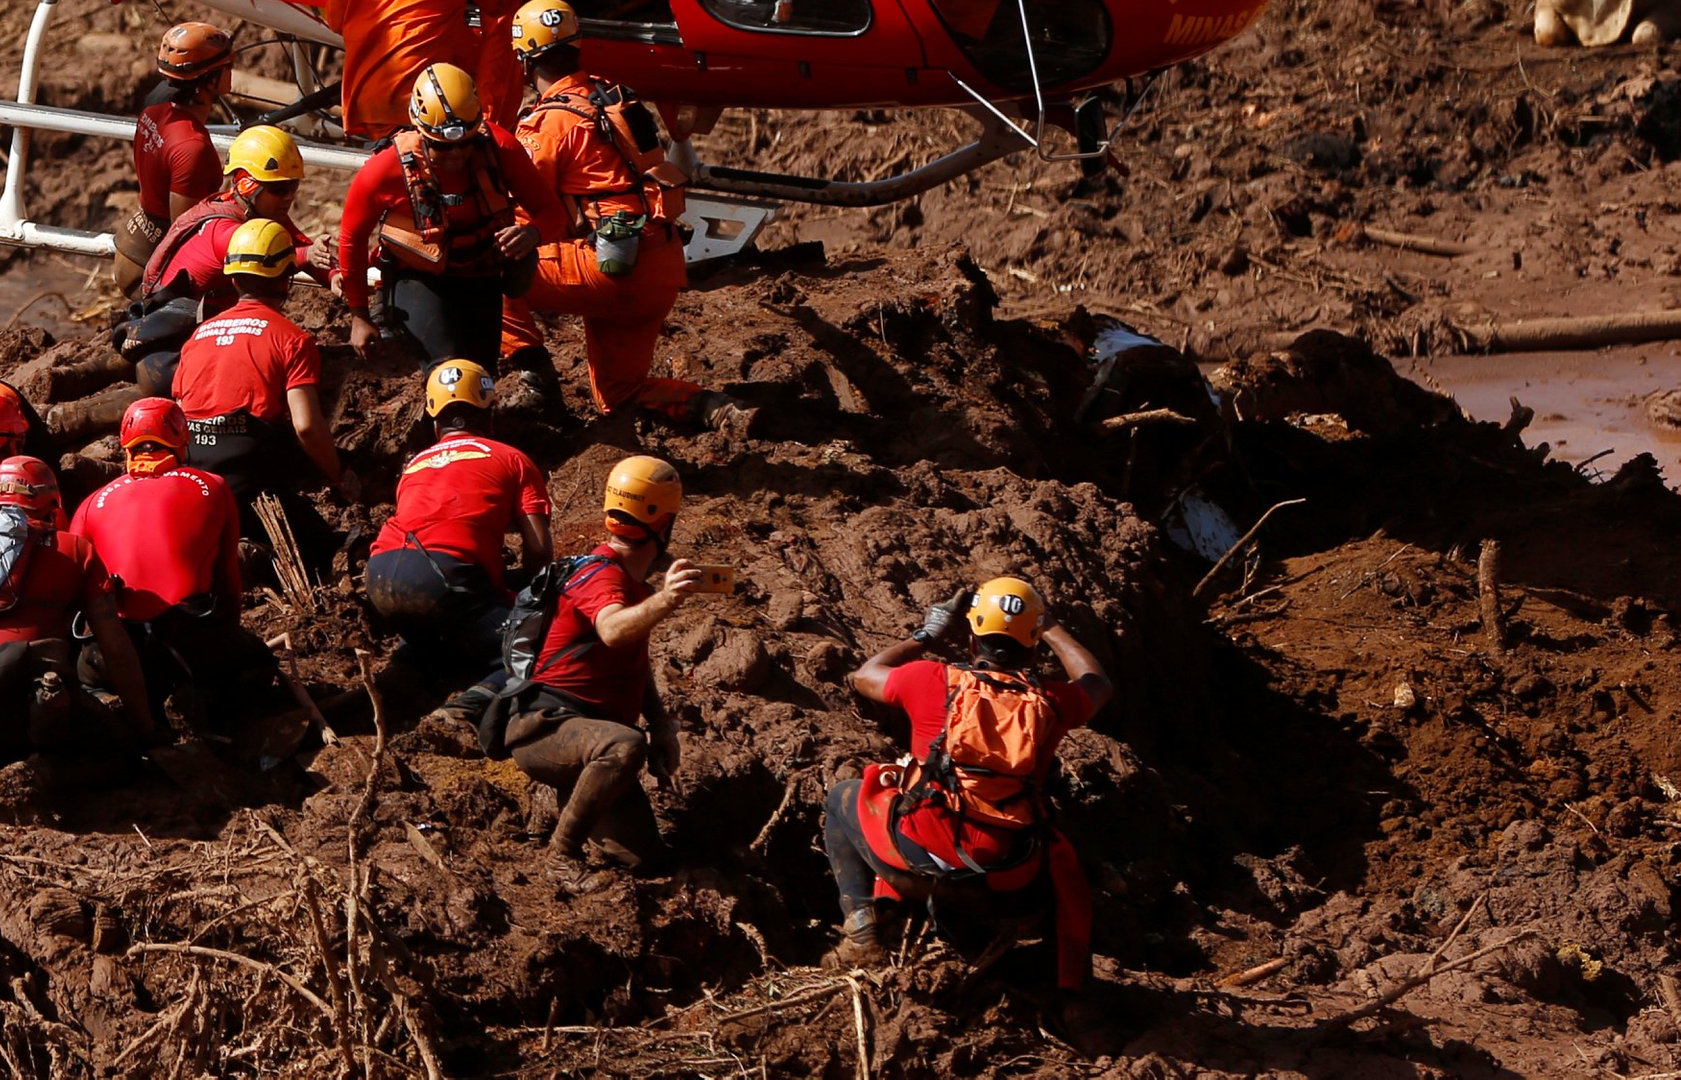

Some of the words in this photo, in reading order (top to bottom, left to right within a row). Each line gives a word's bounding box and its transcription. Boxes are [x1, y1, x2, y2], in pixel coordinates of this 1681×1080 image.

[542, 9, 561, 26] 05
[194, 327, 226, 340] MINAS
[227, 325, 263, 336] GERAIS
[198, 318, 268, 332] BOMBEIROS
[215, 335, 235, 346] 193
[440, 367, 459, 384] 04
[195, 434, 217, 446] 193
[1004, 595, 1022, 613] 10
